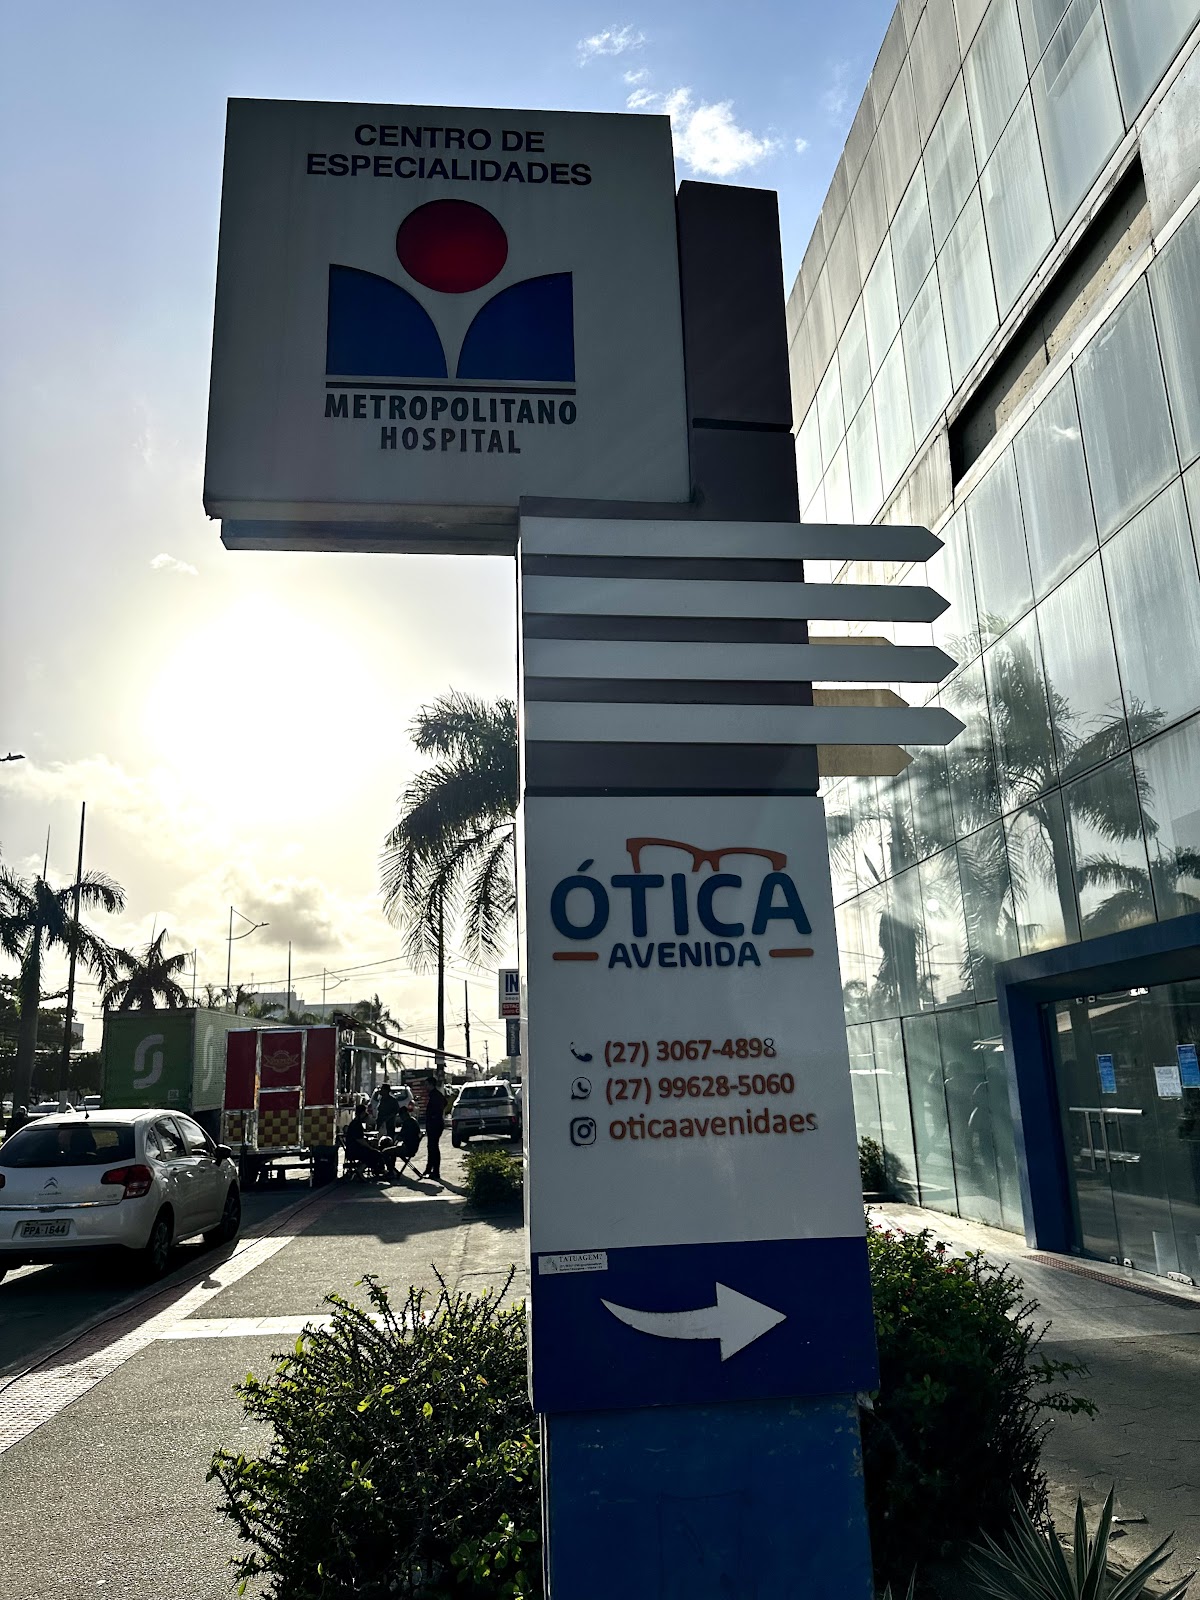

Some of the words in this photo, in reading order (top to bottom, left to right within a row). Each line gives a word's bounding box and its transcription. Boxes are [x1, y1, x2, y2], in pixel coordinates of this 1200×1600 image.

[354, 124, 492, 151] CENTRO
[501, 130, 546, 153] DE
[306, 153, 593, 186] ESPECIALIDADES
[324, 393, 578, 425] METROPOLITANO
[380, 426, 522, 454] HOSPITAL
[550, 858, 813, 940] ÓTICA
[608, 941, 762, 969] AVENIDA
[604, 1040, 649, 1068] (27)
[656, 1037, 777, 1062] 3067-4898
[605, 1077, 652, 1105] (27)
[658, 1072, 795, 1098] 99628-5060
[608, 1107, 819, 1140] oticaavenidaes
